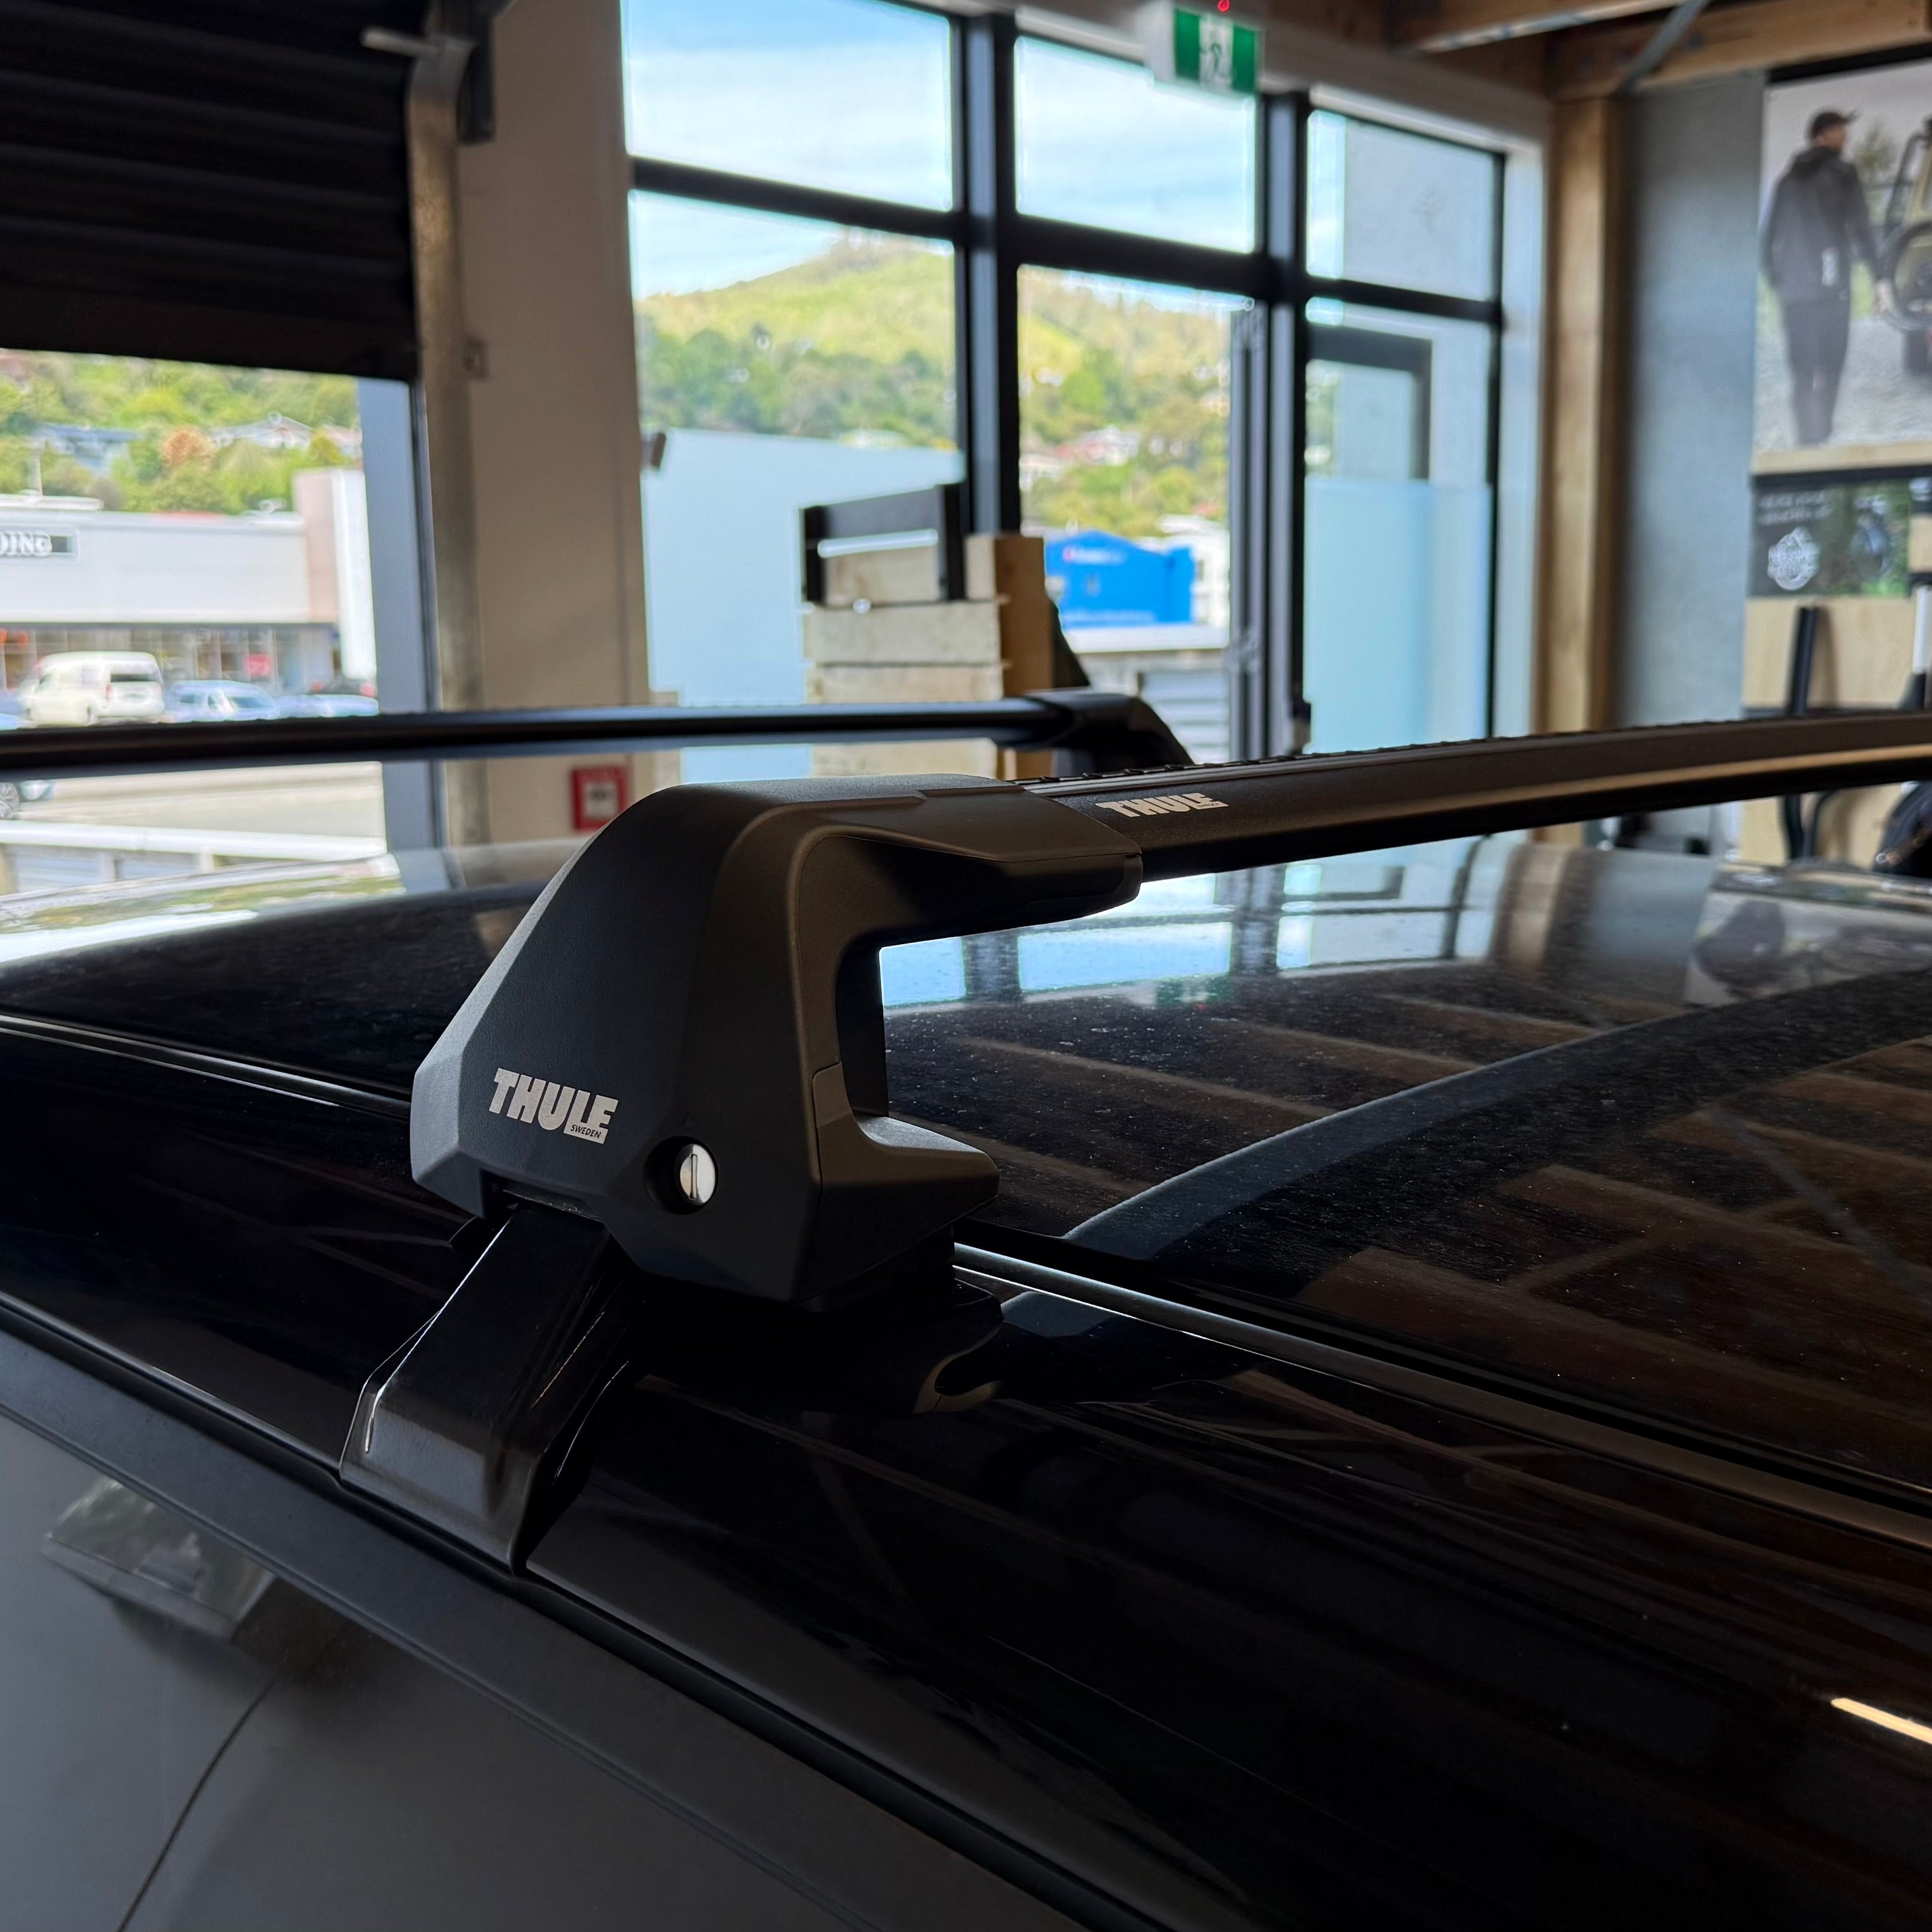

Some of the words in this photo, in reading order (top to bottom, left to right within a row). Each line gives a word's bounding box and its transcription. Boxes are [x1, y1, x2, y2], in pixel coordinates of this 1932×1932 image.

[1095, 793, 1228, 817] THULE
[489, 1068, 618, 1144] THULE
[570, 1124, 601, 1138] SWEDEN
